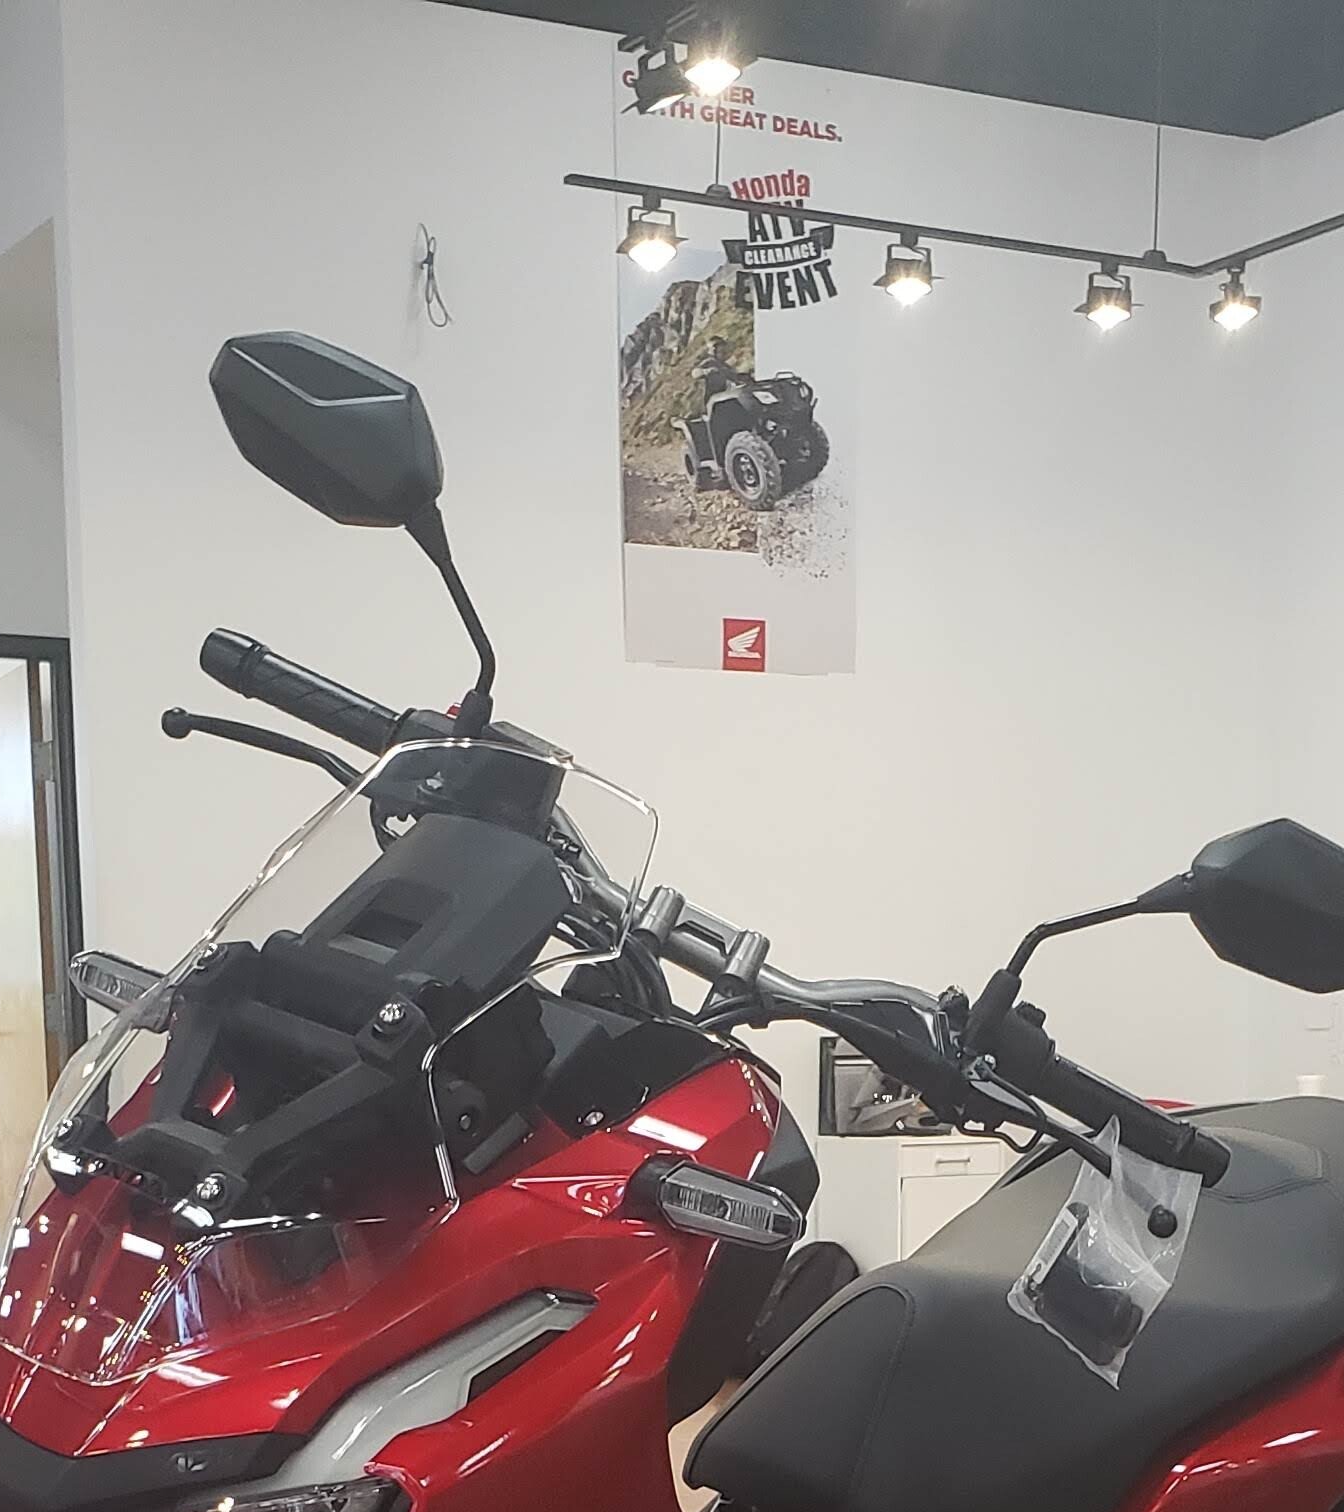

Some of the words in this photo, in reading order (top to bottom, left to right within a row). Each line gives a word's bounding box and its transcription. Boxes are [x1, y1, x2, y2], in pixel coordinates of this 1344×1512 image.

[700, 104, 767, 131] GREAT
[772, 115, 843, 142] DEALS.
[732, 168, 811, 201] Honda
[744, 241, 817, 266] CLEARANCE
[736, 259, 839, 310] EVENT
